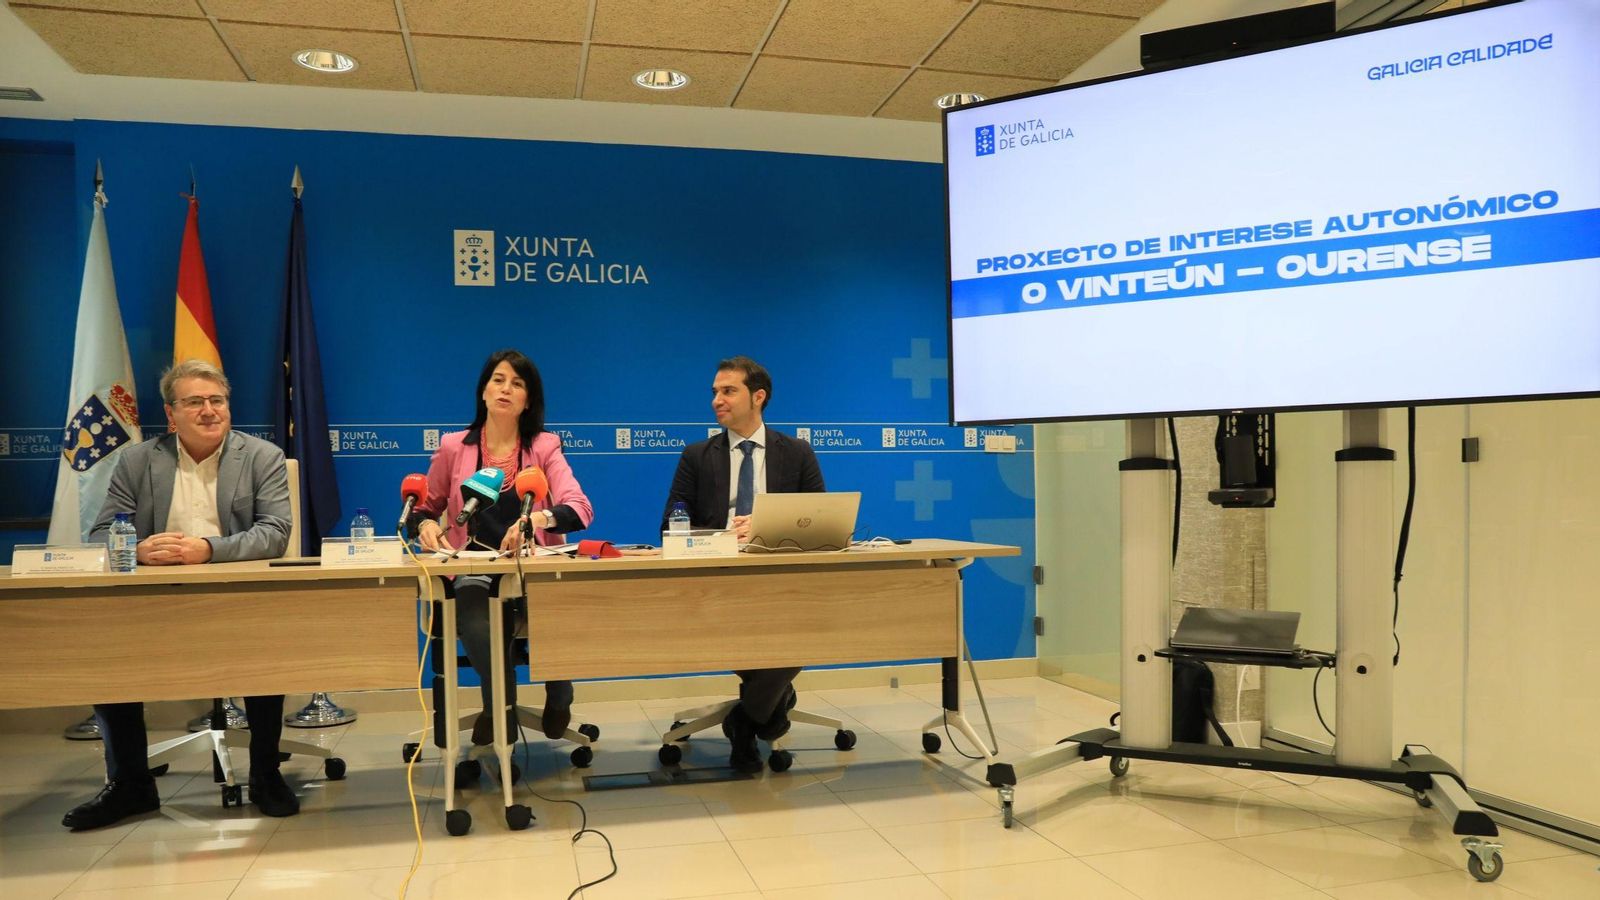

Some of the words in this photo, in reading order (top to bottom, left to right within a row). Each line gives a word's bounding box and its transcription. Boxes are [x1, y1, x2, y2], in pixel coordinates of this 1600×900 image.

[1367, 54, 1443, 81] GALICIA
[1446, 33, 1554, 67] CALIDADE
[1000, 119, 1045, 136] XUNTA
[999, 137, 1016, 150] DE
[1020, 128, 1075, 147] GALICIA
[976, 242, 1117, 274] PROXECTO
[1125, 237, 1161, 257] DE
[1169, 219, 1313, 252] INTERESE
[1322, 189, 1559, 235] AUTONÓMICO
[505, 236, 595, 258] XUNTA
[504, 262, 537, 282] DE
[546, 262, 650, 285] GALICIA
[1021, 282, 1047, 305] O
[1057, 258, 1225, 301] VINTEÚN
[1276, 234, 1492, 280] OURENSE
[343, 431, 378, 440] XUNTA
[633, 430, 666, 438] XUNTA
[813, 429, 844, 437] XUNTA
[898, 429, 928, 437] XUNTA
[13, 435, 51, 444] XUNTA
[562, 439, 594, 448] ALICIA
[633, 439, 645, 447] DE
[648, 439, 686, 447] GALICIA
[813, 438, 825, 446] DE
[827, 438, 862, 446] GALICIA
[898, 438, 909, 446] DE
[911, 438, 945, 446] GALICIA
[13, 444, 28, 454] DE
[343, 441, 355, 450] DE
[358, 441, 400, 450] GALICIA
